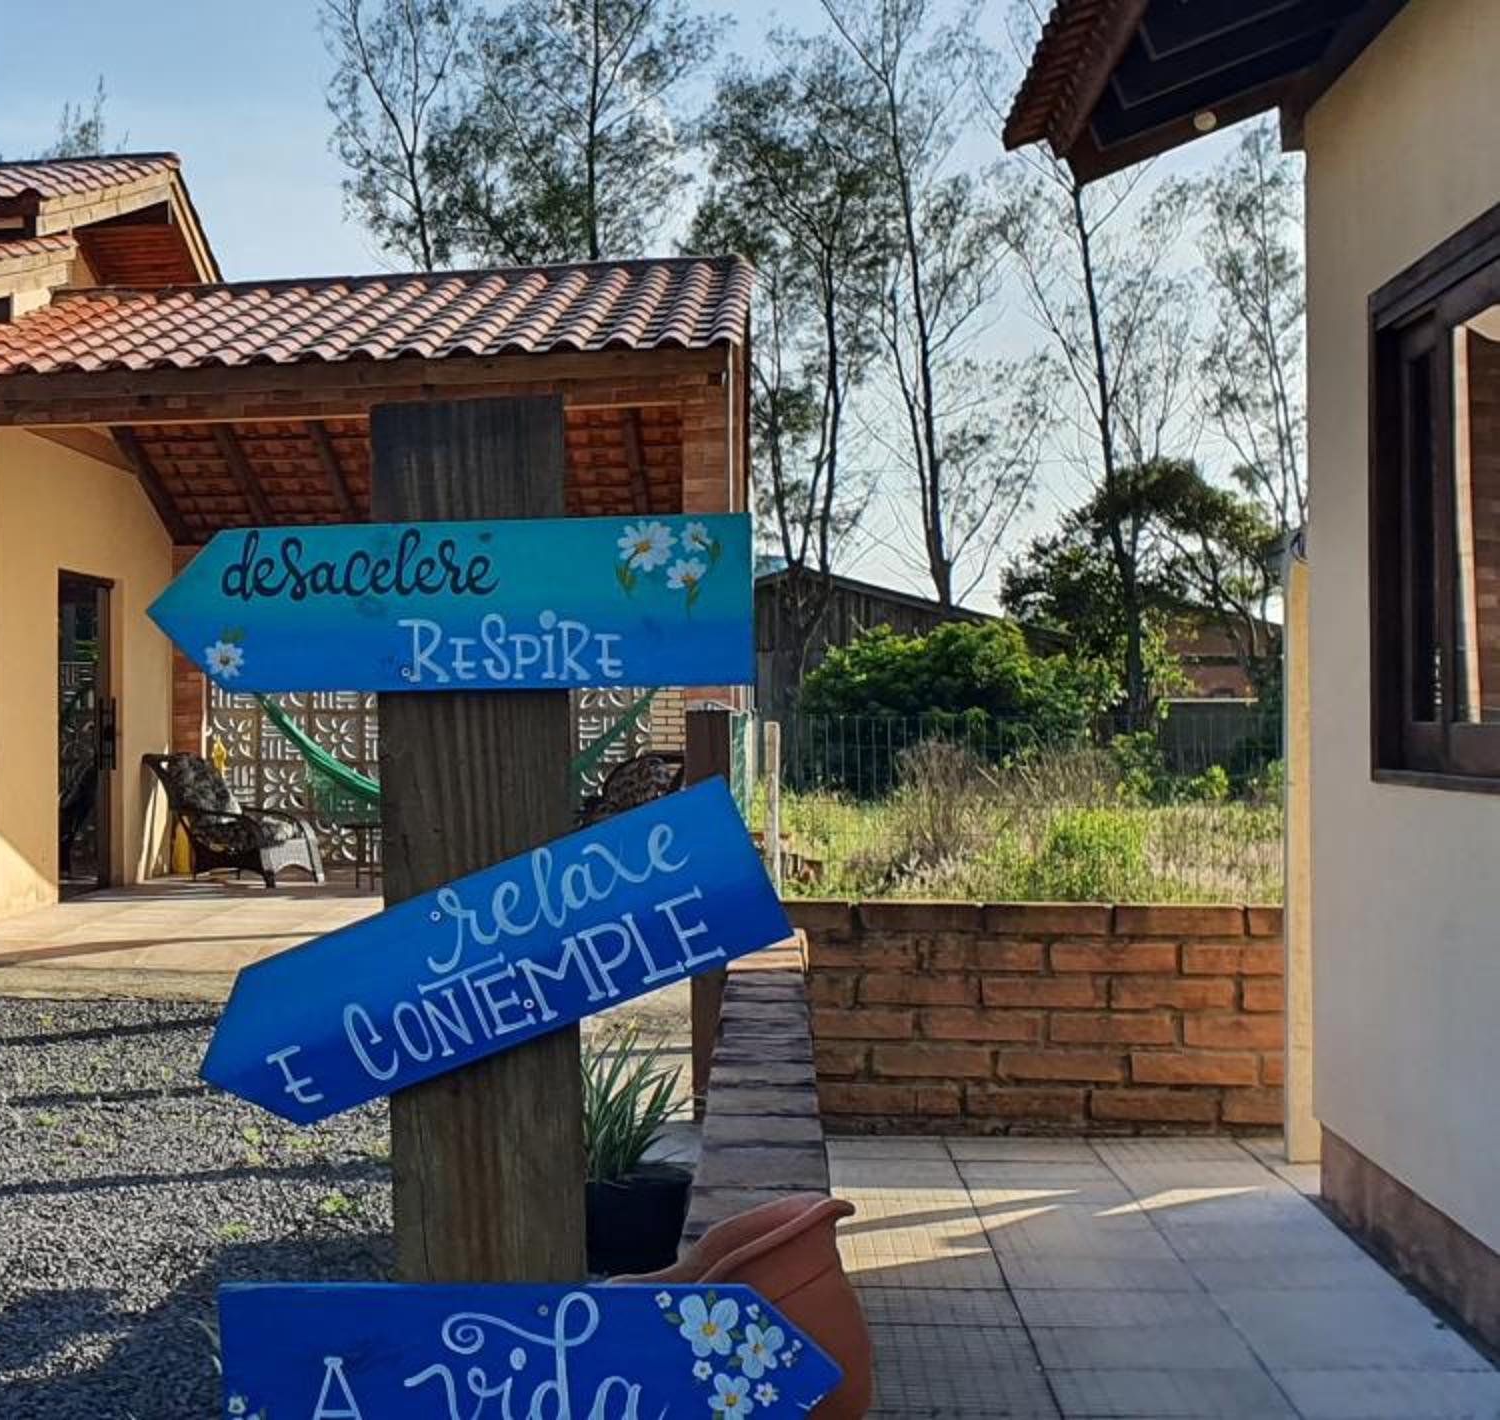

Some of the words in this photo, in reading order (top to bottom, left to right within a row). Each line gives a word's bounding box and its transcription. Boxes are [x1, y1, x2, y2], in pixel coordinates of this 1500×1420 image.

[427, 822, 692, 974] relaxe
[266, 1044, 325, 1104] E
[343, 886, 727, 1082] CONTEMPLE
[312, 1356, 363, 1420] A
[402, 1290, 668, 1420] vida
